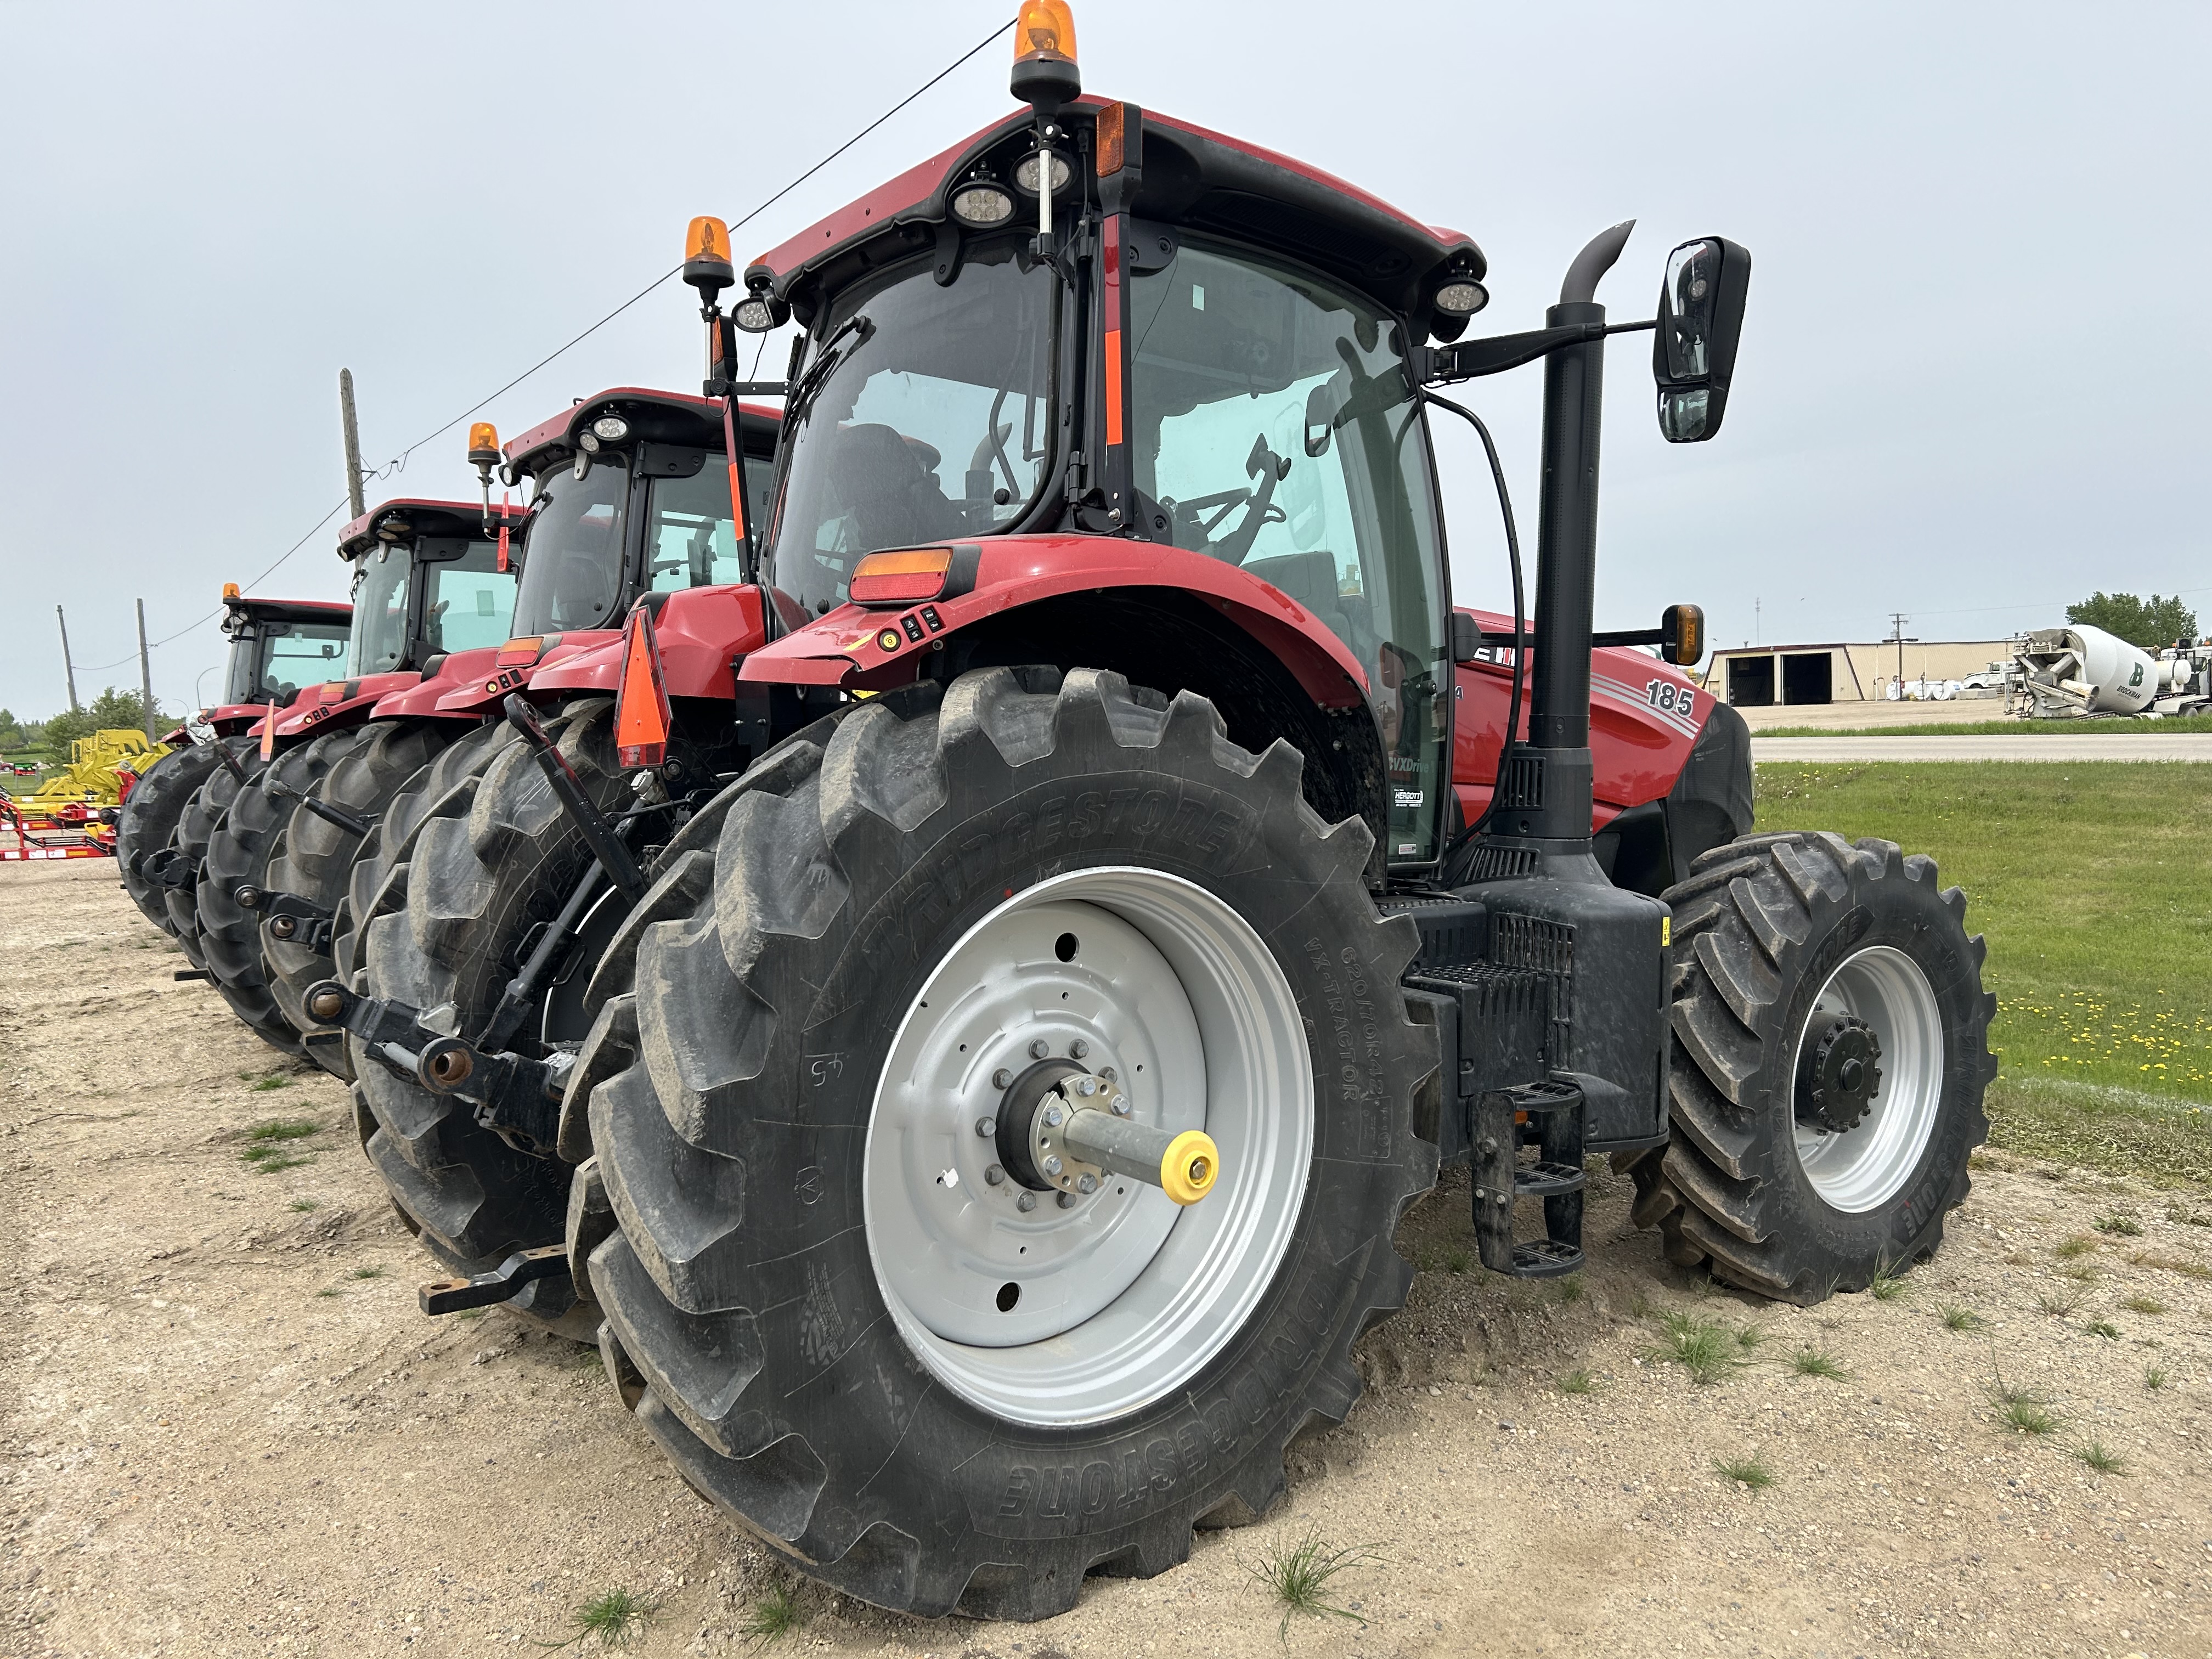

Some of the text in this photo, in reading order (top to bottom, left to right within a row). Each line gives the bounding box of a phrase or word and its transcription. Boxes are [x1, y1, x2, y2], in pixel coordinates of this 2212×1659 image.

[1646, 678, 1695, 718] 185
[2116, 685, 2142, 700] BROCKMAN
[1395, 792, 1420, 800] HERGOTT
[1304, 937, 1361, 1102] VX-TRACTOR
[1340, 946, 1385, 1096] 620/70R42
[996, 1272, 1342, 1521] BRIDGESTONE
